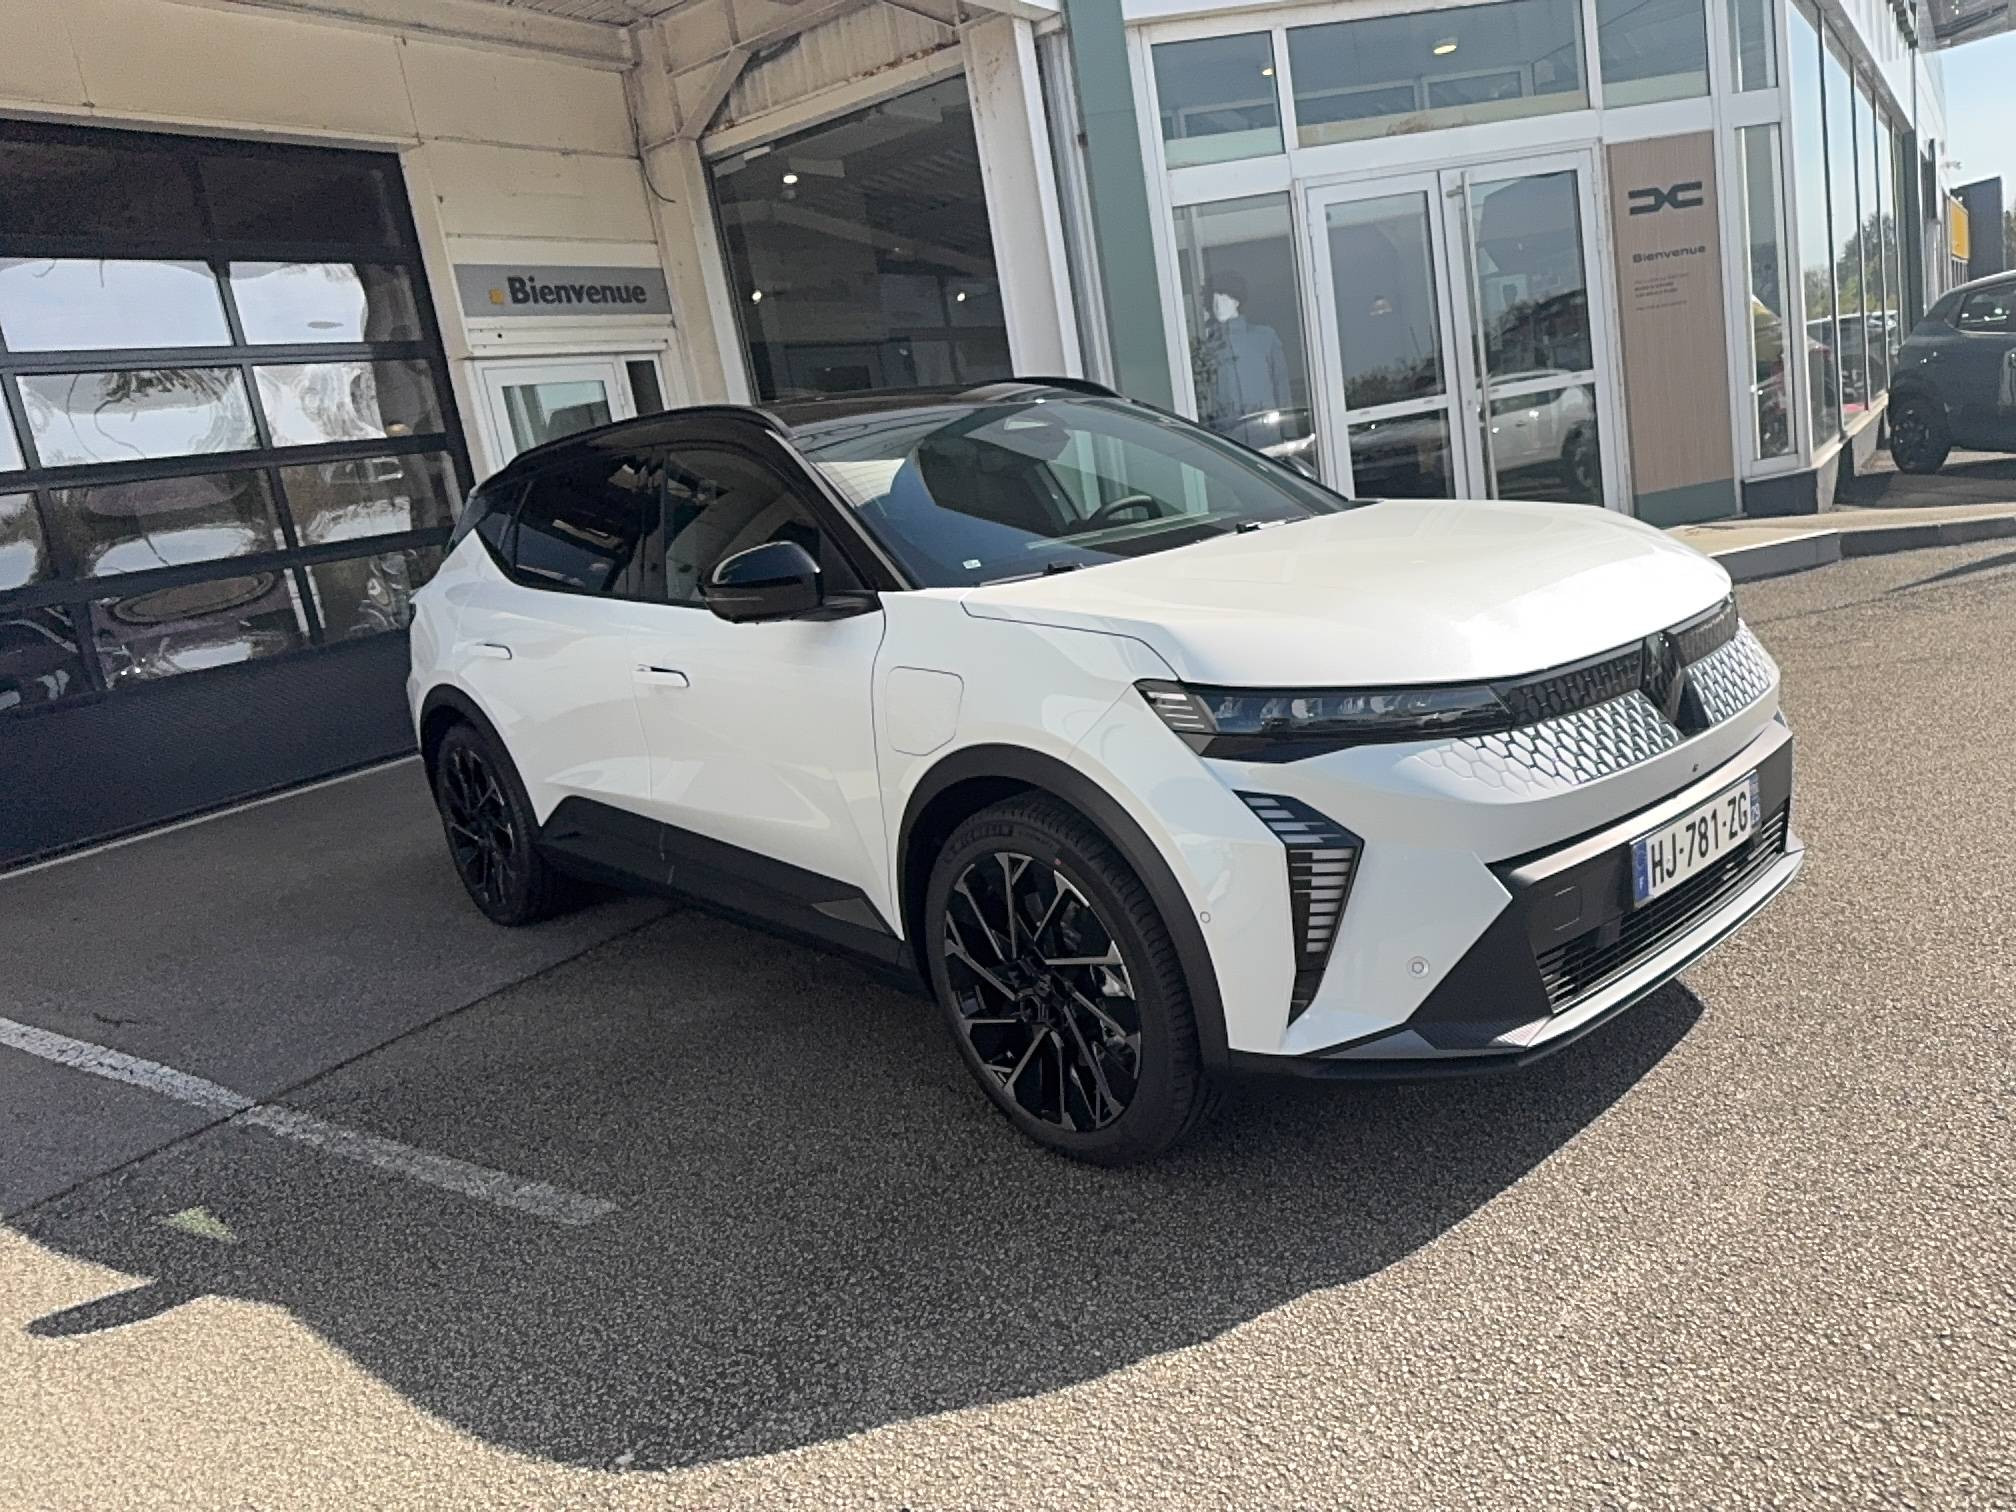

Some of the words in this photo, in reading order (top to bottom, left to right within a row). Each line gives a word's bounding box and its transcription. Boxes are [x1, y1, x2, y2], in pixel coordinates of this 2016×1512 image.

[1633, 246, 1706, 263] Bienvenue
[507, 275, 647, 304] Bienvenue
[1651, 791, 1748, 888] HJ-781-ZG
